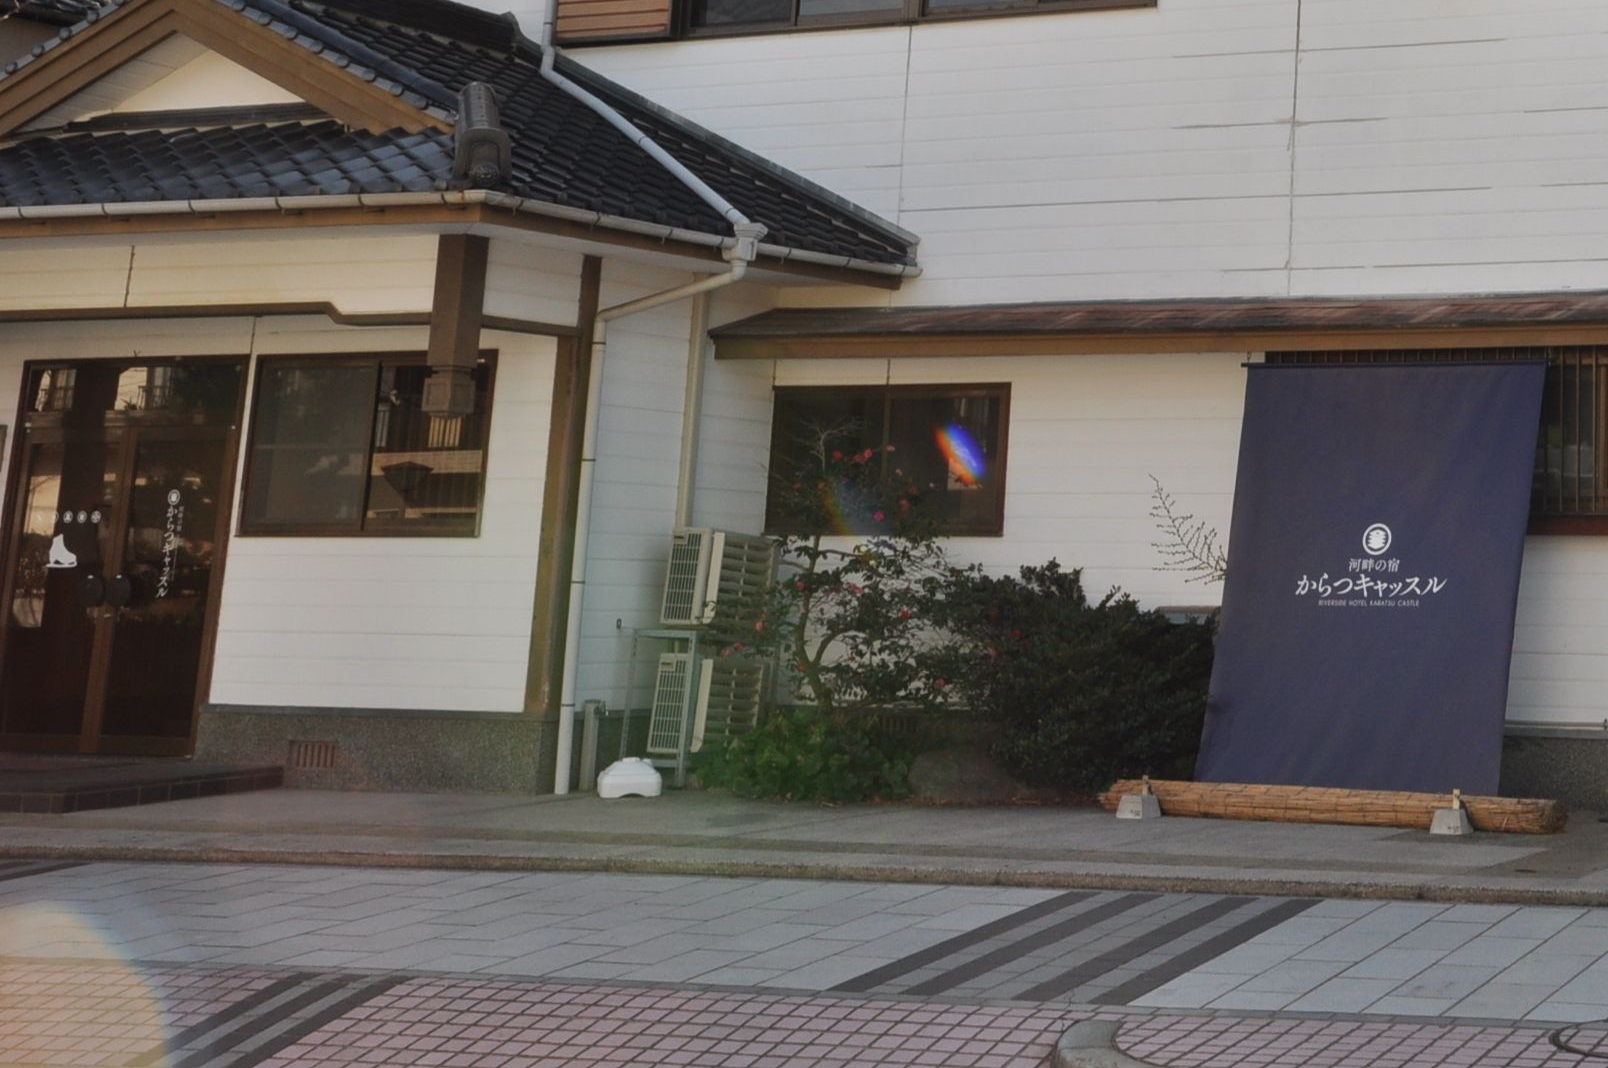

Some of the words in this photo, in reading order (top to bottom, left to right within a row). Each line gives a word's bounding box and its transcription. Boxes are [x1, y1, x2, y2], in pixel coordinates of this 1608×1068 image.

[155, 505, 178, 598] からつキャッスル
[1349, 558, 1400, 573] 河畔の宿
[1295, 572, 1448, 598] からつキャッスル
[1318, 599, 1347, 607] RIVERSIDE
[1348, 599, 1368, 607] HOTEL
[1369, 599, 1396, 607] KARATSU
[1397, 599, 1420, 607] CASTLE
